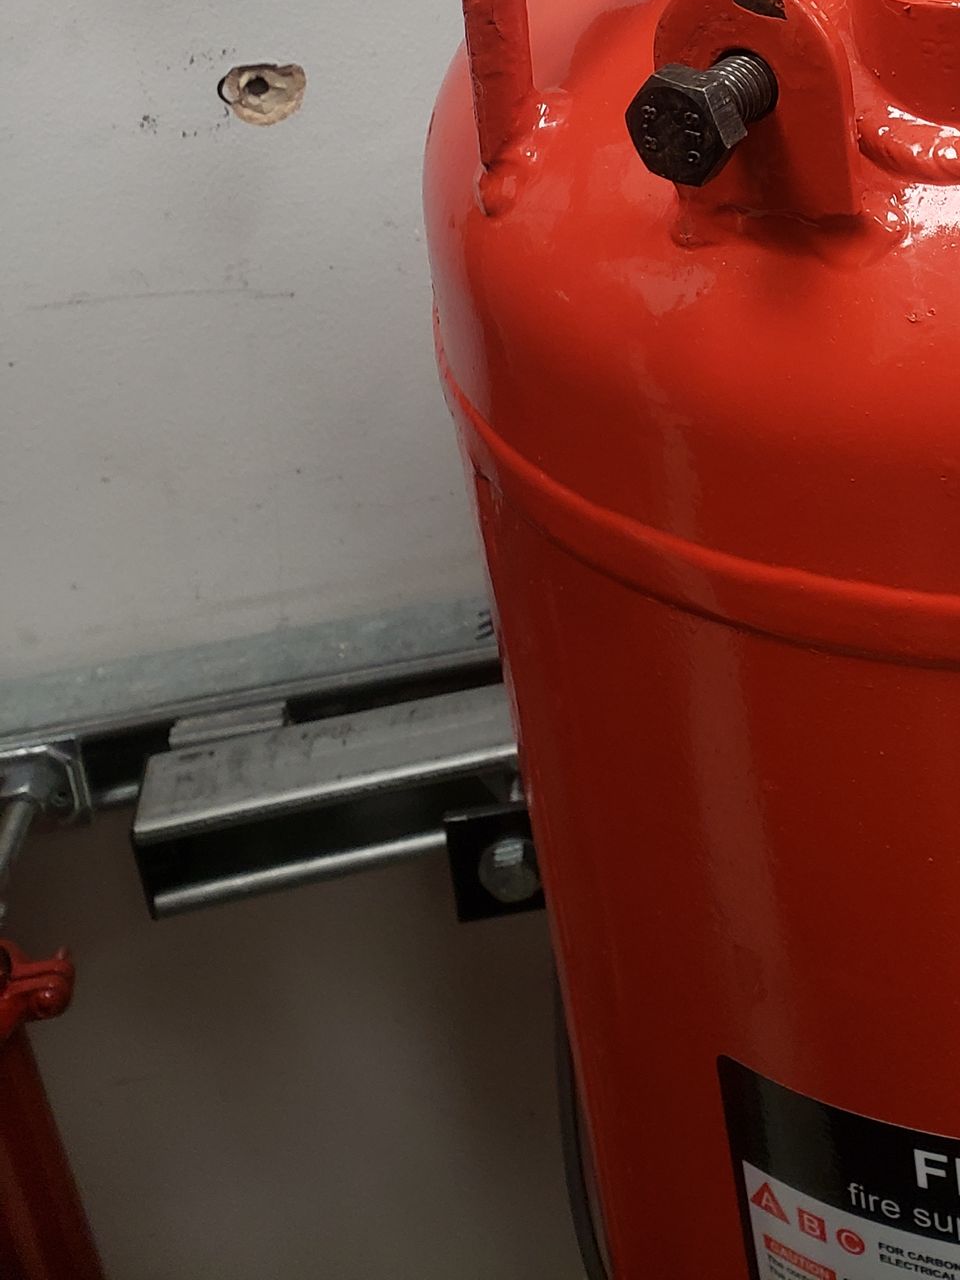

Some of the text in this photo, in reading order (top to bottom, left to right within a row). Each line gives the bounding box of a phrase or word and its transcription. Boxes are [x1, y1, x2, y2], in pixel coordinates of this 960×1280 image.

[847, 1182, 901, 1220] fire
[803, 1214, 820, 1236] B
[840, 1231, 861, 1253] C
[878, 1241, 905, 1257] FOR
